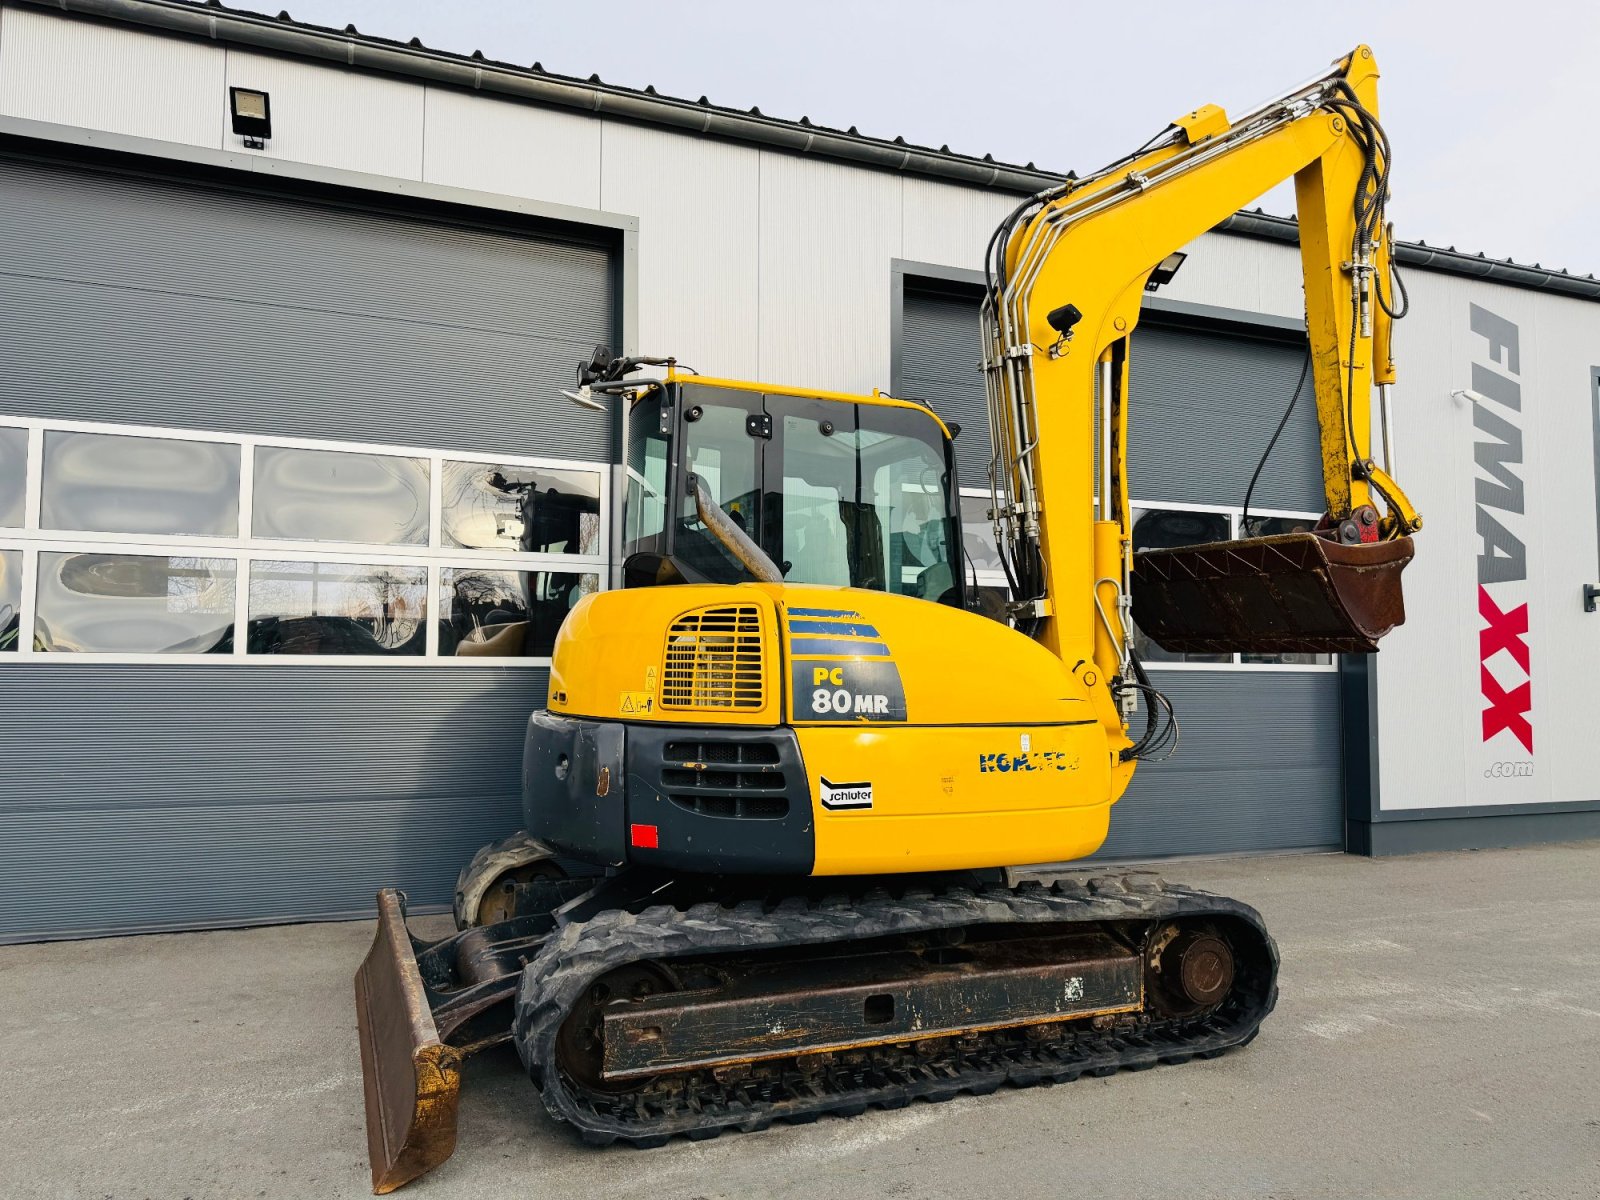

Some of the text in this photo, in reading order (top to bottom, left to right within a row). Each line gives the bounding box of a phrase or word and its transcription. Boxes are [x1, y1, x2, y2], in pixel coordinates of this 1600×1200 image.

[1470, 301, 1534, 756] FIMAXX
[813, 667, 843, 686] PC
[1483, 761, 1534, 779] .com
